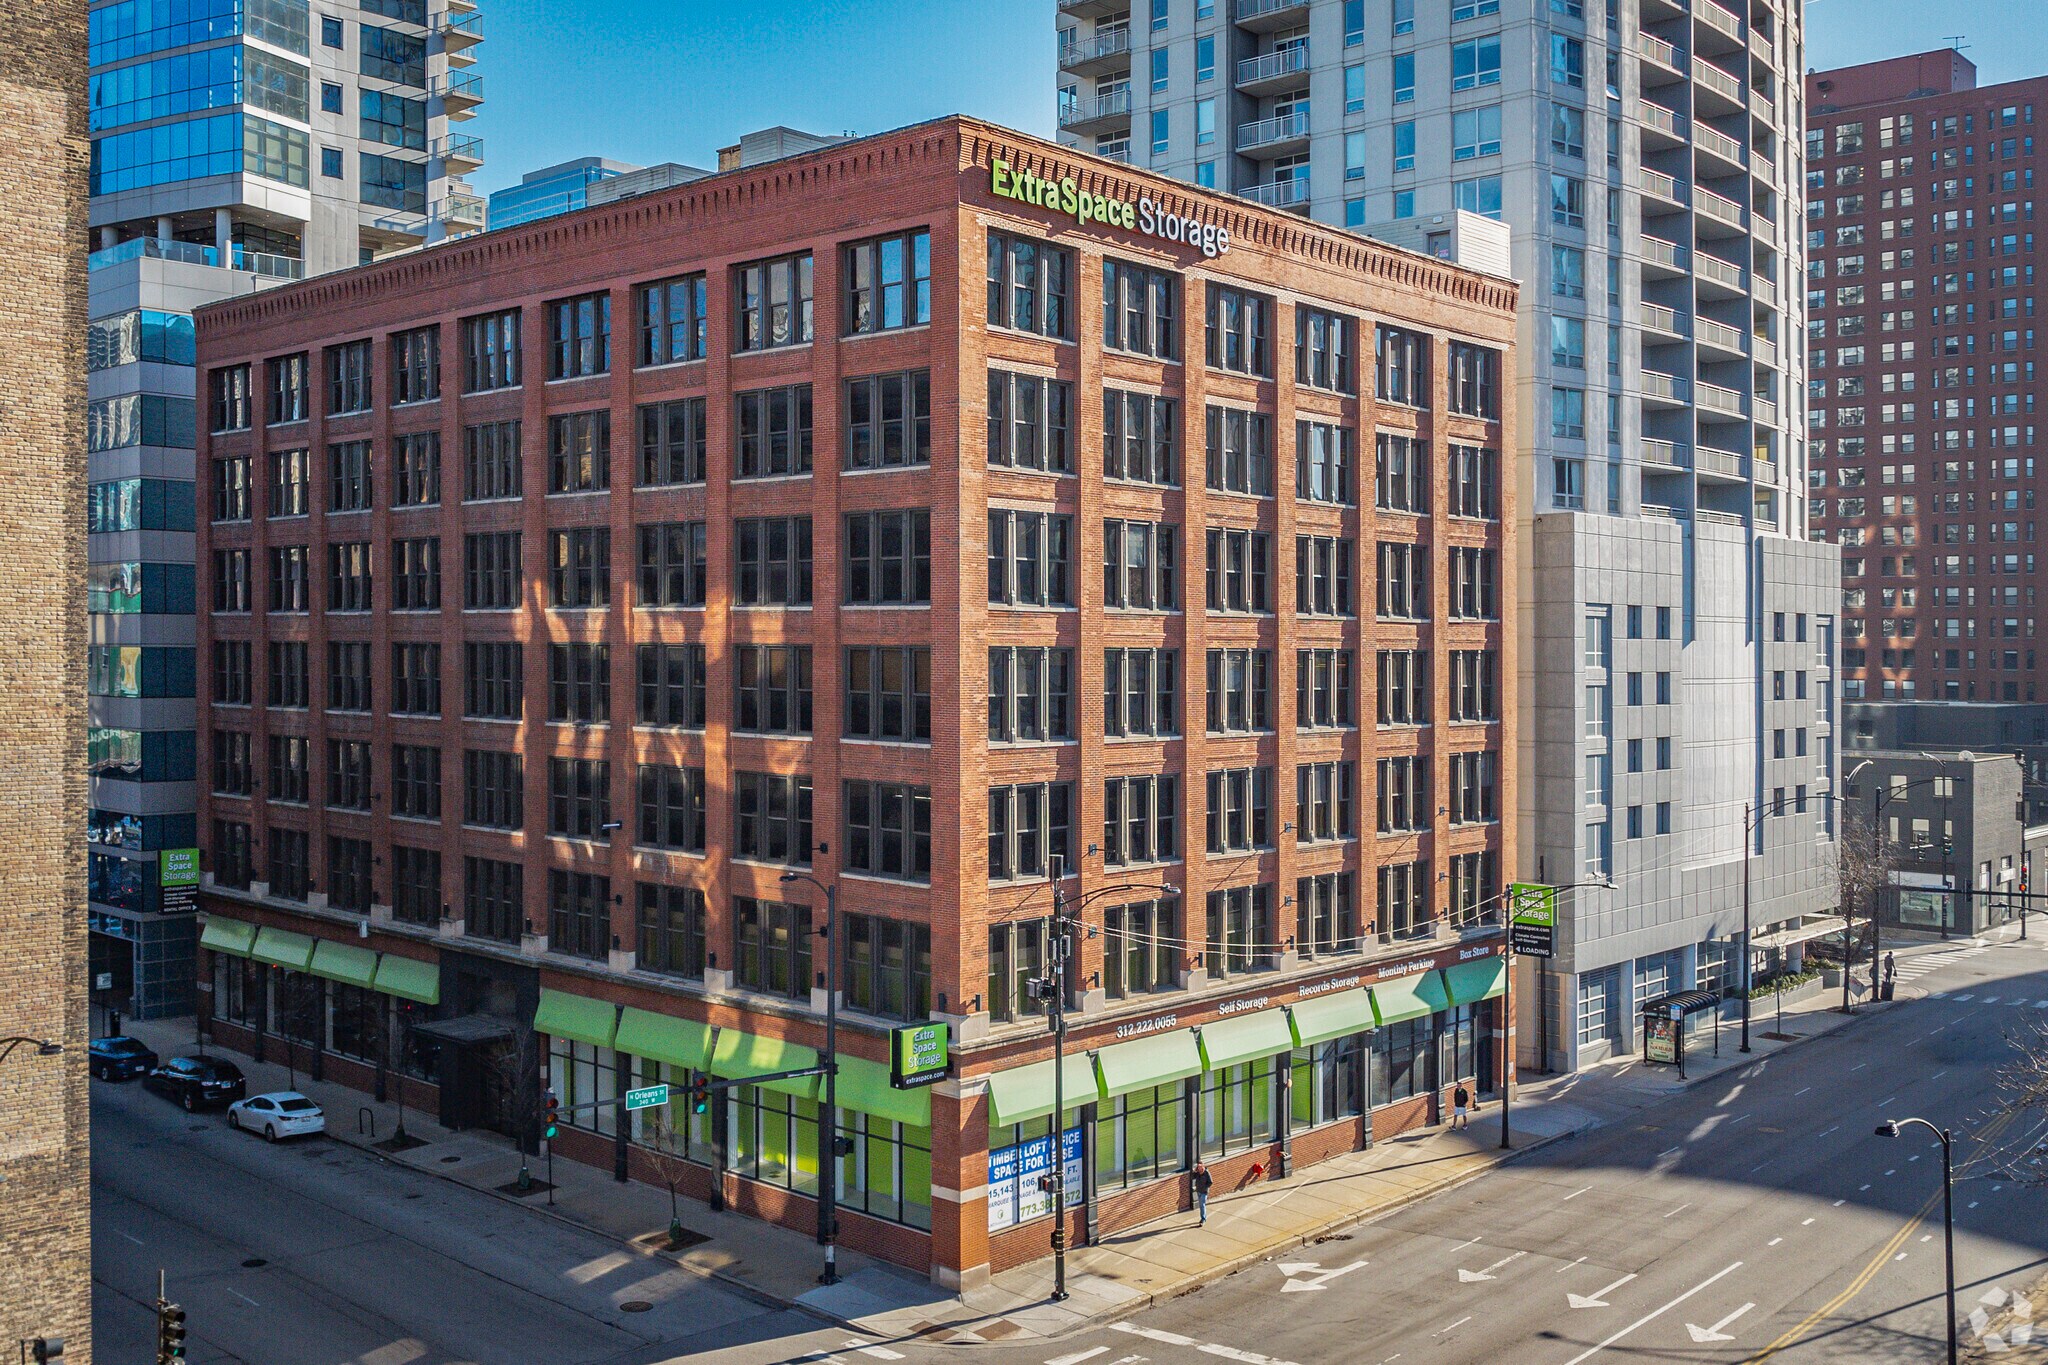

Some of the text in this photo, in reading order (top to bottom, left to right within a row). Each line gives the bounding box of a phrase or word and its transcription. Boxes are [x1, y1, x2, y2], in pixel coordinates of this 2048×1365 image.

[991, 158, 1230, 258] ExtraSpace Storage
[169, 853, 190, 861] Extra
[168, 862, 192, 871] Space
[163, 871, 196, 881] Storage
[1521, 888, 1543, 898] Extra
[1519, 897, 1545, 908] Space
[1515, 908, 1550, 920] Storage
[1459, 946, 1489, 960] Box Store
[1522, 947, 1550, 956] LOADING
[1378, 957, 1435, 979] Monthly Parking
[1298, 974, 1360, 997] Records Storage
[1218, 995, 1269, 1015] Self Storage
[1116, 1013, 1177, 1038] 312.222.0055
[914, 1030, 935, 1042] Extra
[913, 1041, 937, 1055] Space
[908, 1053, 941, 1069] Storage
[906, 1071, 945, 1085] extraspace.com
[634, 1090, 658, 1100] Orleans
[1024, 1141, 1047, 1158] LOFT
[994, 1146, 1073, 1180] SPACE FOR LESE
[988, 1184, 1014, 1199] 15,143
